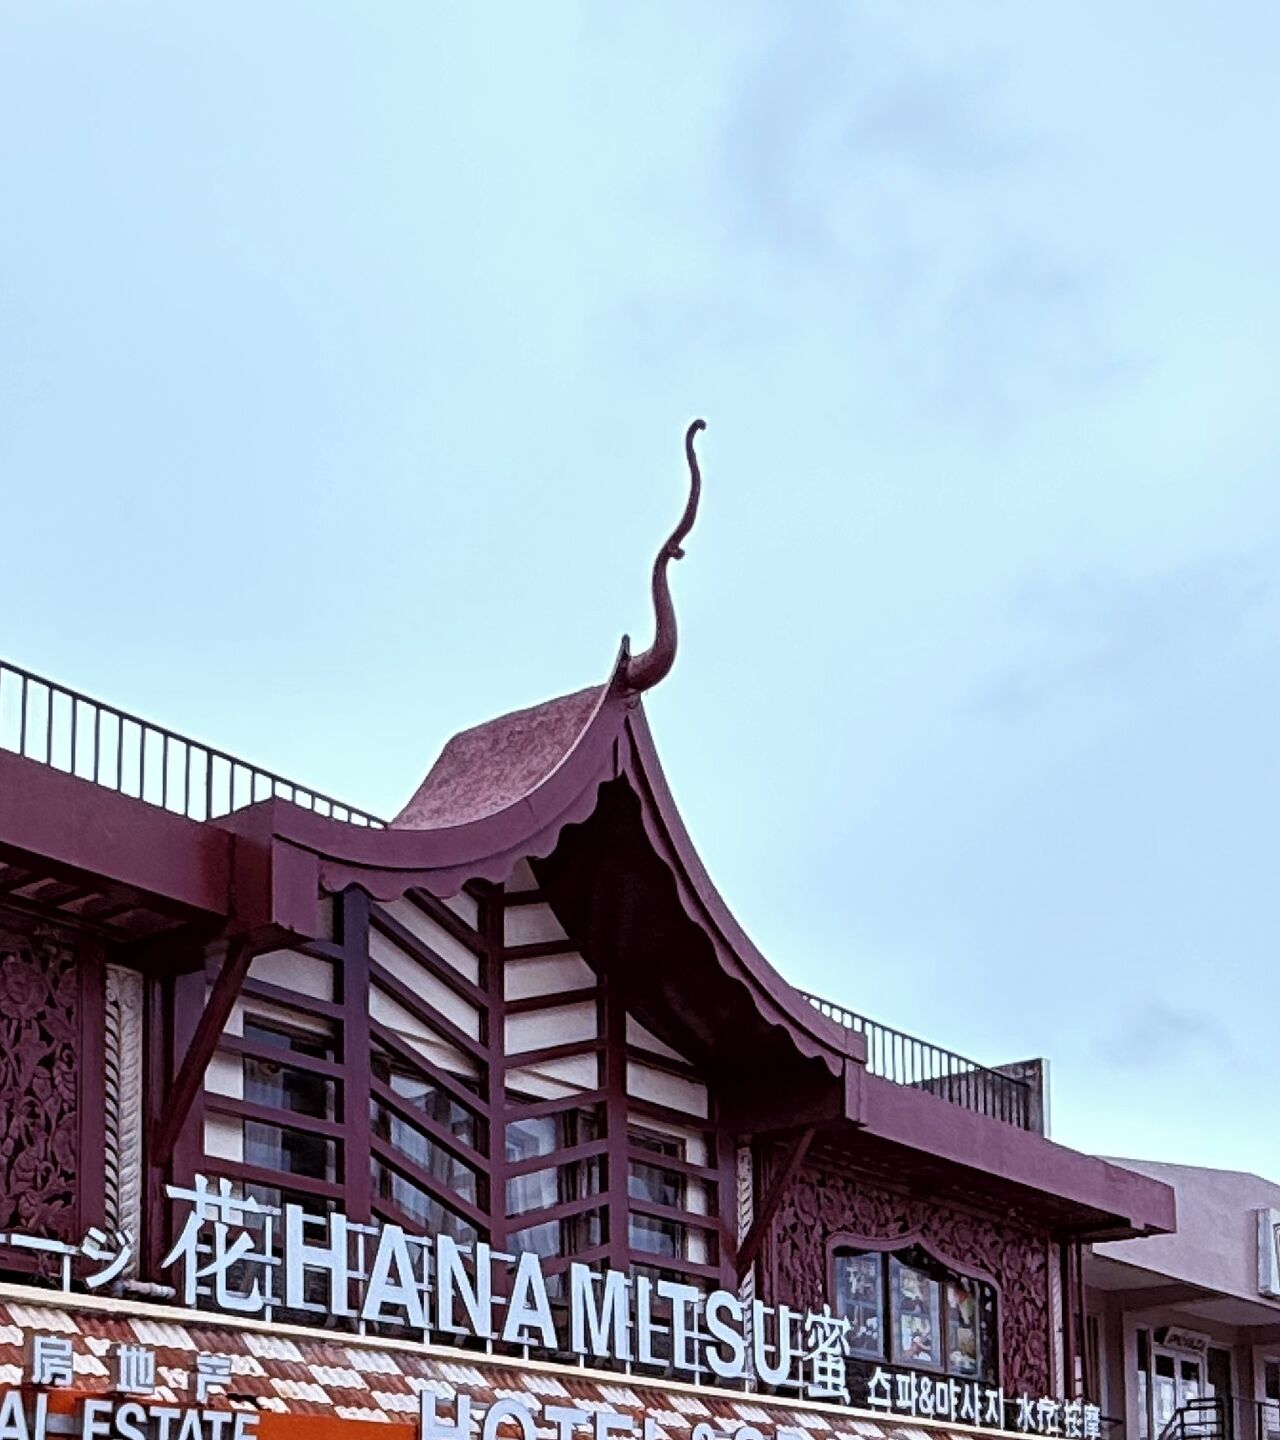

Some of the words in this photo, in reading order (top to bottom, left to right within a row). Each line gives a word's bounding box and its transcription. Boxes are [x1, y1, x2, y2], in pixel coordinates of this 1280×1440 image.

[161, 1174, 265, 1313] 花
[285, 1203, 791, 1386] HANAMITSU
[800, 1303, 851, 1406] 蜜
